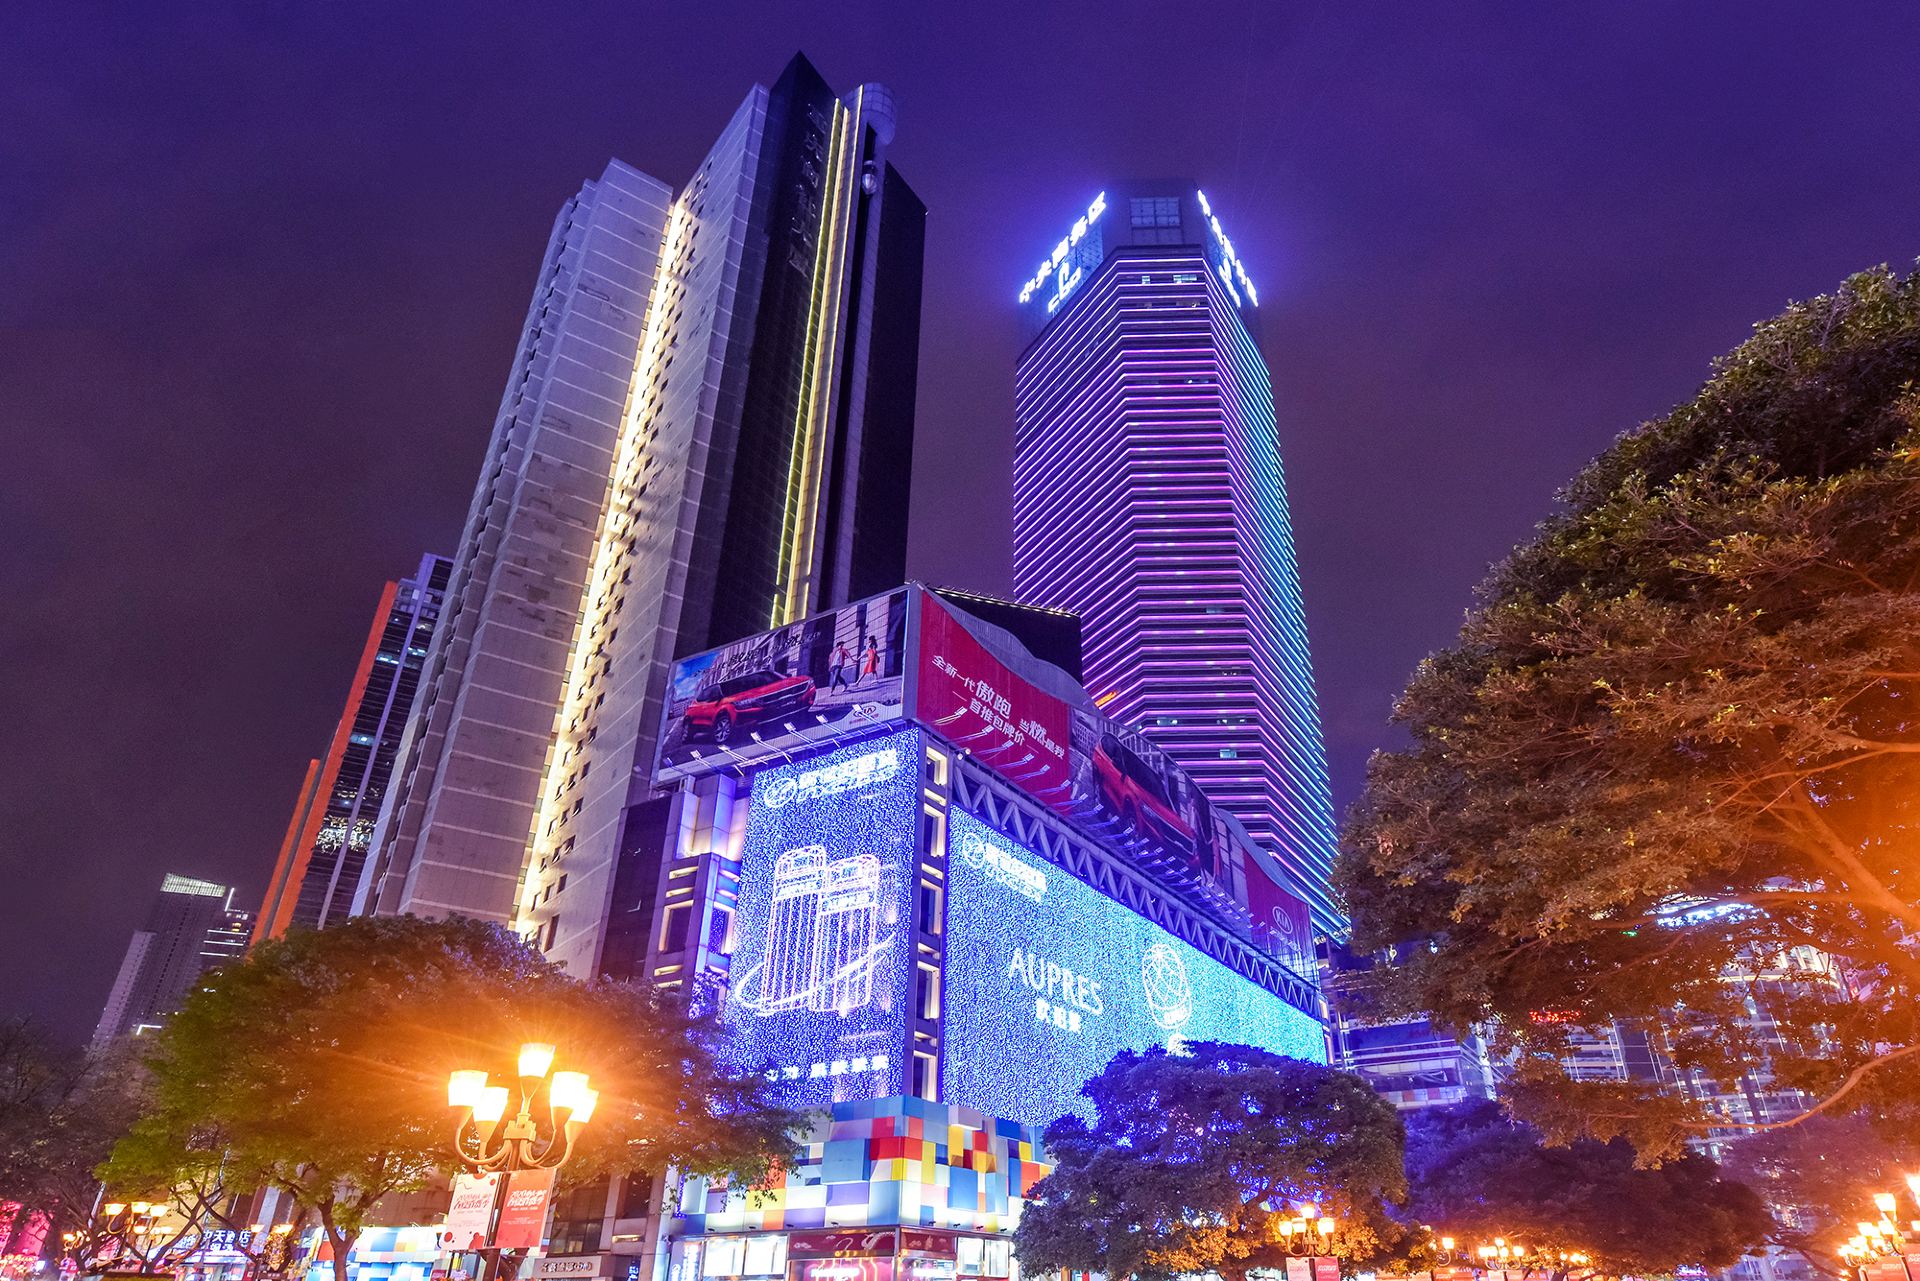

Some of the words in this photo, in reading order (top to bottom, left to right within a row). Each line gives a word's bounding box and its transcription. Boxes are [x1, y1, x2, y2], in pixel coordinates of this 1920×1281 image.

[969, 698, 1025, 747] 首推包牌价
[1008, 947, 1104, 1015] AUPRES
